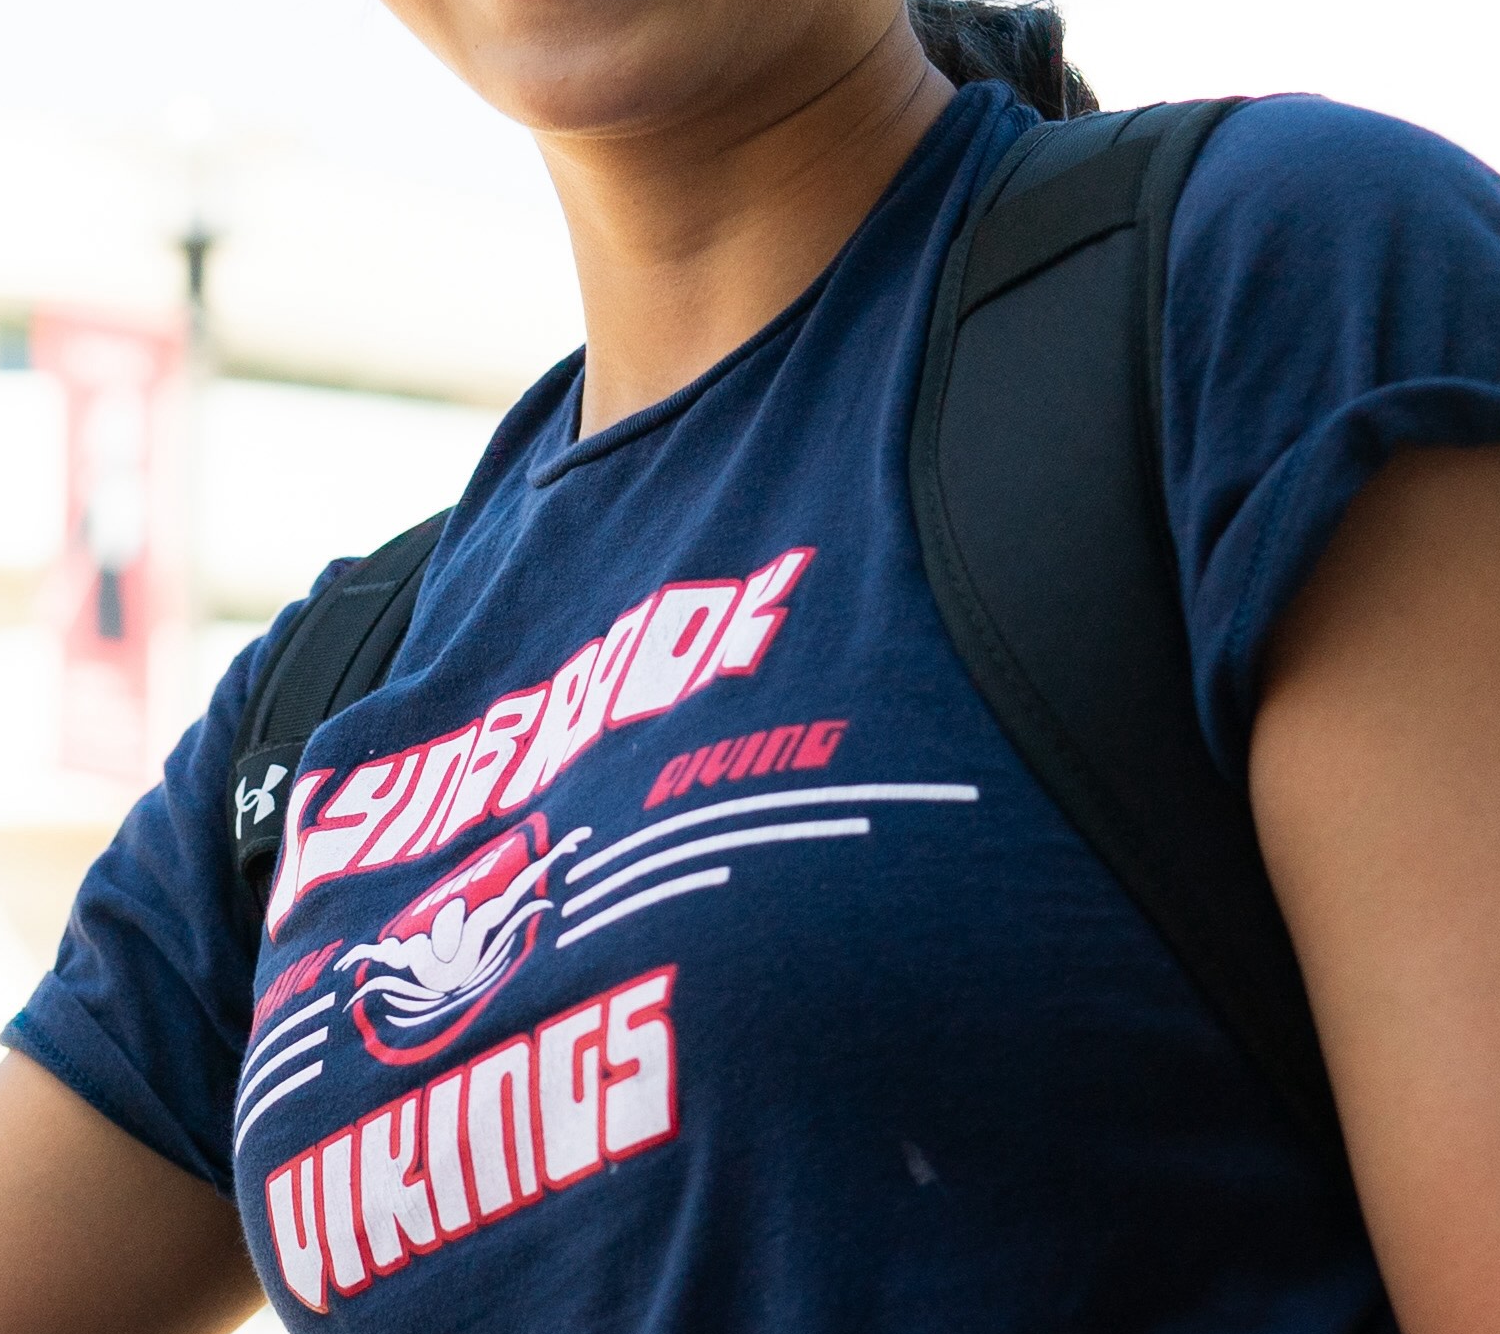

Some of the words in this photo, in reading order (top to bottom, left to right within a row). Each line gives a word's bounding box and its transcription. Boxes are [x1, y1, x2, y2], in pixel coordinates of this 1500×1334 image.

[267, 546, 818, 945] LYNBROOK
[642, 719, 849, 802] DIVING
[266, 963, 680, 1315] VIKINGS
